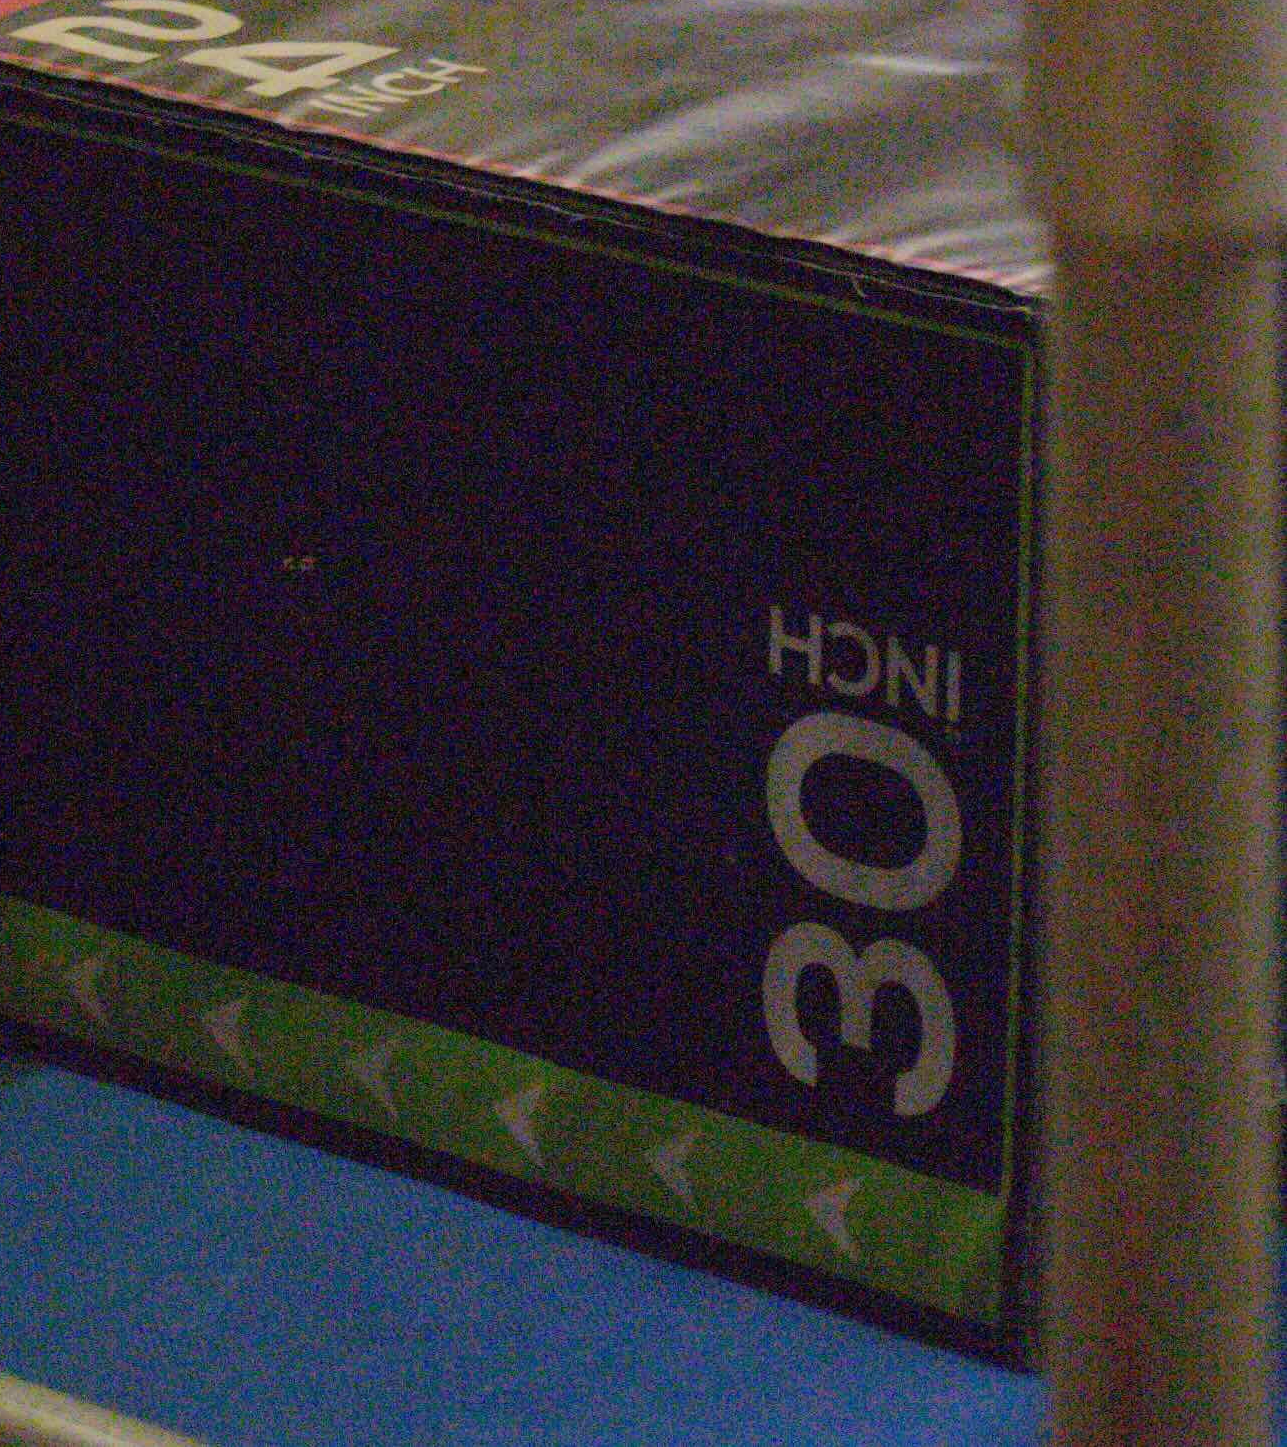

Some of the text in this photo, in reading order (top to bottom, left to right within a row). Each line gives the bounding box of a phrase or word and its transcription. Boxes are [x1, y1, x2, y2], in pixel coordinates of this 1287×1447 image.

[312, 56, 488, 120] INCH
[768, 604, 961, 723] INCH
[762, 711, 963, 1117] 30
